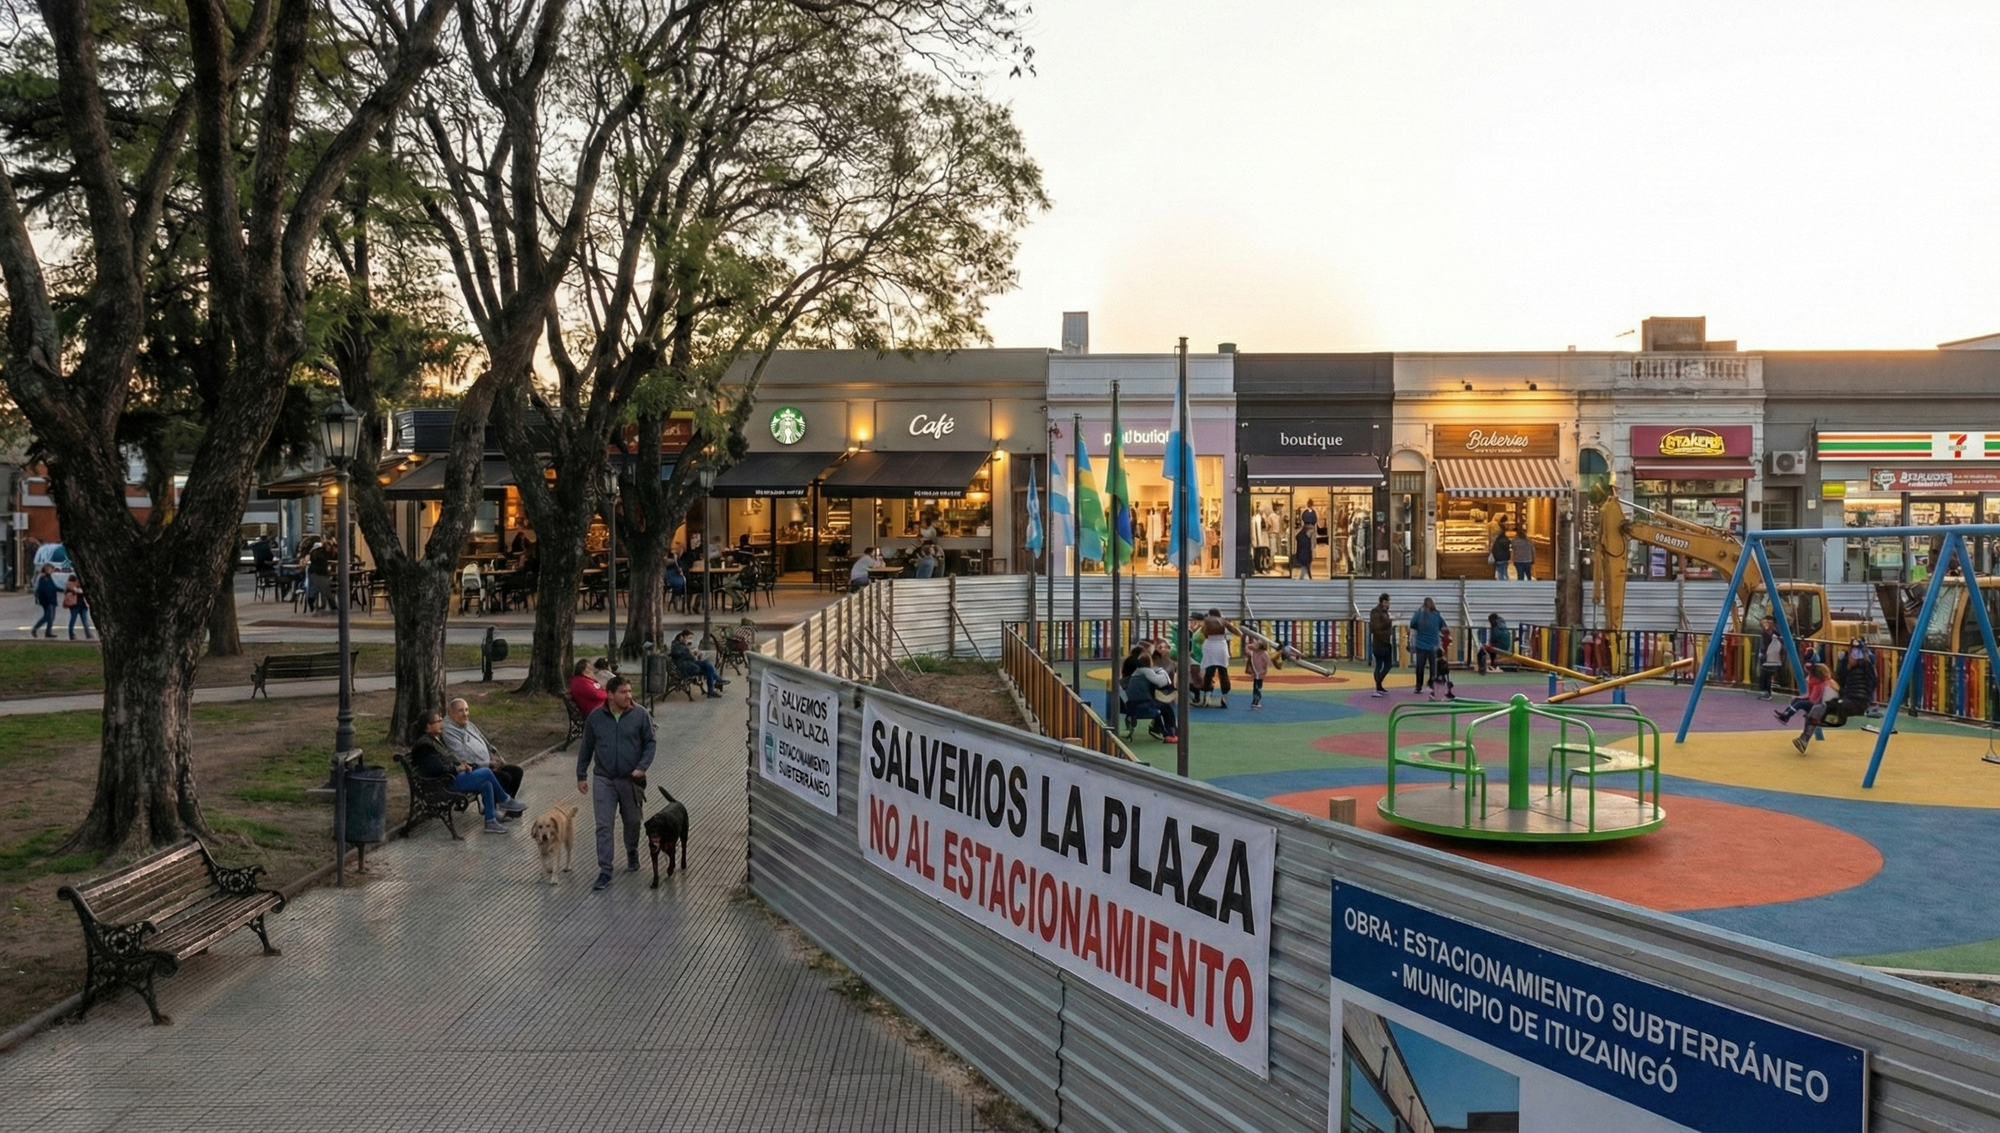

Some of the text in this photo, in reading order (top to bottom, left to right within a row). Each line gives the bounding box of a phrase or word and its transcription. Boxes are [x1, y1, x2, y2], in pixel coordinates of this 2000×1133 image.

[909, 413, 955, 439] Café
[1280, 432, 1343, 450] boutique
[1466, 429, 1529, 450] Bakeries
[781, 690, 827, 721] SALVEMOS
[782, 712, 830, 747] LA PLAZA
[869, 719, 1256, 936] SALVEMOS LA PLAZA
[869, 794, 1254, 1043] NO AL ESTACIONAMIENTO
[1344, 907, 1829, 1103] OBRA: ESTACIONAMIENTO SUBTERRÁNEO
[1403, 963, 1504, 1024] MUNICIPIO
[1510, 1005, 1538, 1040] DE
[1545, 1019, 1678, 1094] ITUZAINGÓ
